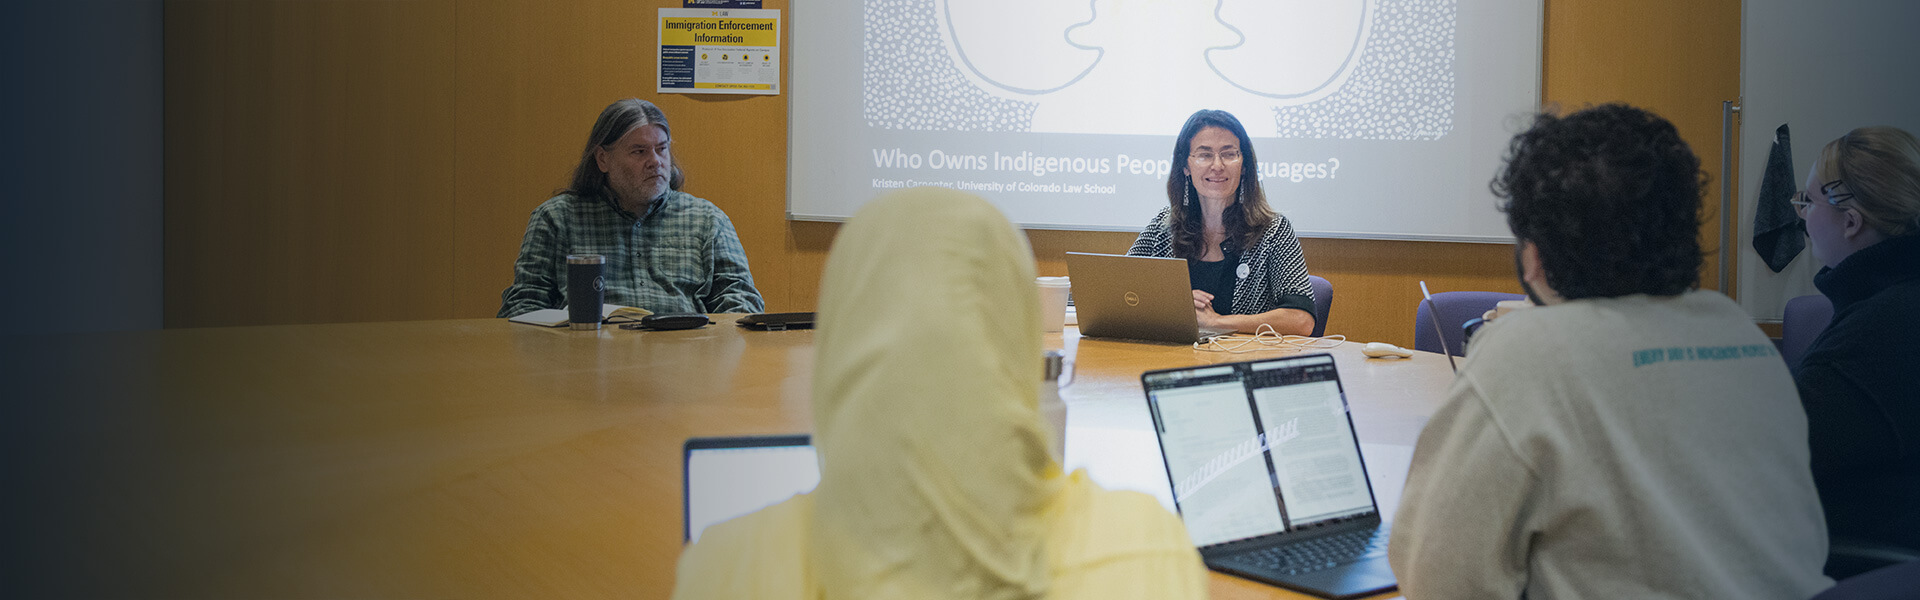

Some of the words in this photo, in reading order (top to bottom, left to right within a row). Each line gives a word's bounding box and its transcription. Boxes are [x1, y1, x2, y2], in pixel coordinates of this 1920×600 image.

[666, 20, 716, 32] Immigration
[719, 20, 773, 30] Enforcement
[694, 33, 744, 43] Information
[872, 148, 922, 169] Who
[928, 149, 988, 170] Owns
[994, 151, 1110, 177] Indigenous
[1117, 154, 1175, 182] Peop
[1256, 157, 1340, 183] guages?
[872, 178, 904, 189] Kristen
[957, 181, 1003, 193] University
[1006, 181, 1016, 192] of
[1018, 182, 1060, 193] Colorado
[1063, 183, 1083, 194] Law
[1084, 184, 1116, 194] School
